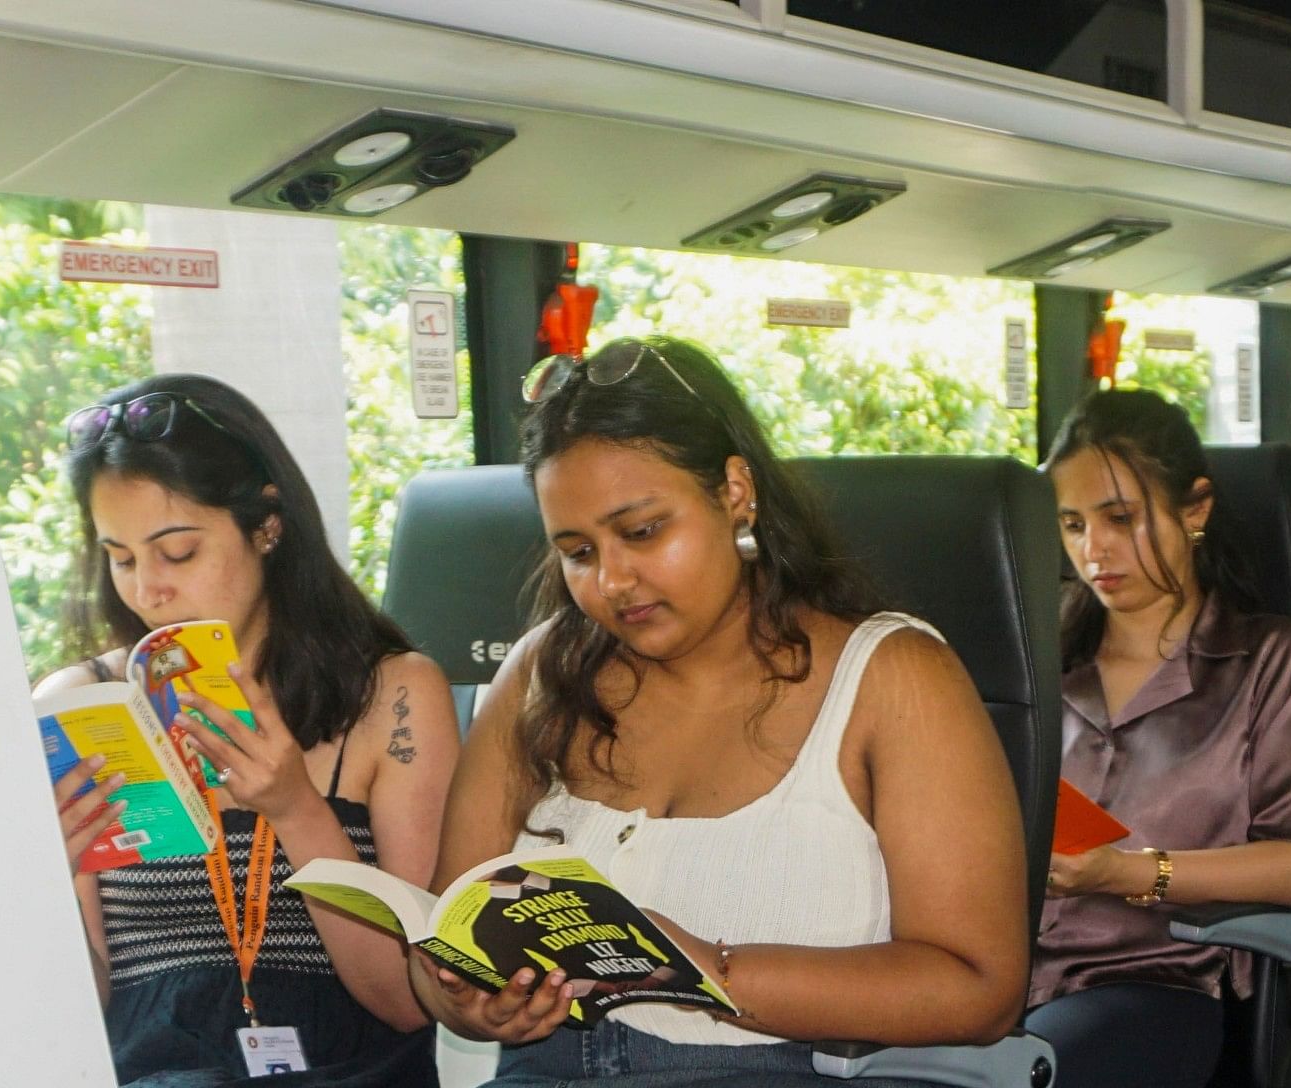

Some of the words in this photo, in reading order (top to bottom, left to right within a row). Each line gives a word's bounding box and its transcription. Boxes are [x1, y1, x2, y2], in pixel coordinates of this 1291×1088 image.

[62, 252, 173, 276] EMERGENCY
[178, 258, 213, 278] EXIT
[250, 855, 265, 903] Random
[502, 890, 591, 924] STRANGE
[535, 908, 594, 932] SALLY
[245, 904, 260, 950] Penguin
[539, 924, 630, 951] DIAMOND
[419, 939, 465, 967] STRANGE
[585, 941, 625, 958] LIZ
[585, 957, 657, 976] NUGENT
